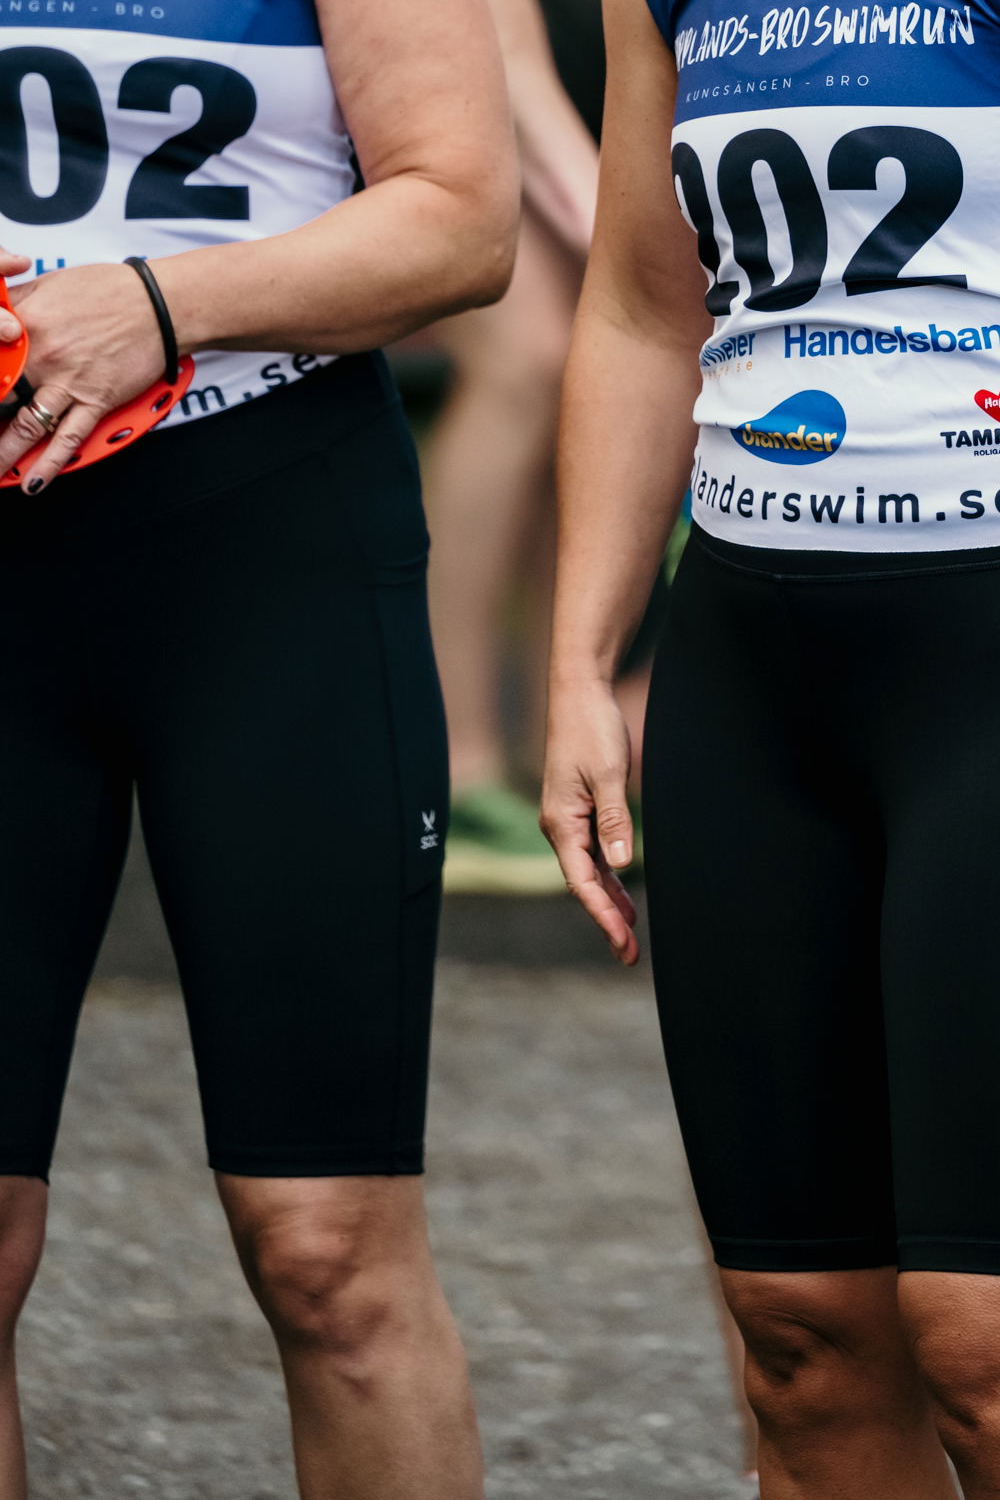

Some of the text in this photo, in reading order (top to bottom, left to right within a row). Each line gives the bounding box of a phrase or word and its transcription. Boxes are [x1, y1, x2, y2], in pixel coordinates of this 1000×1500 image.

[0, 0, 76, 13] NGEN
[115, 2, 165, 20] BRO
[811, 1, 976, 47] SWIMRUN
[825, 74, 869, 88] BRO
